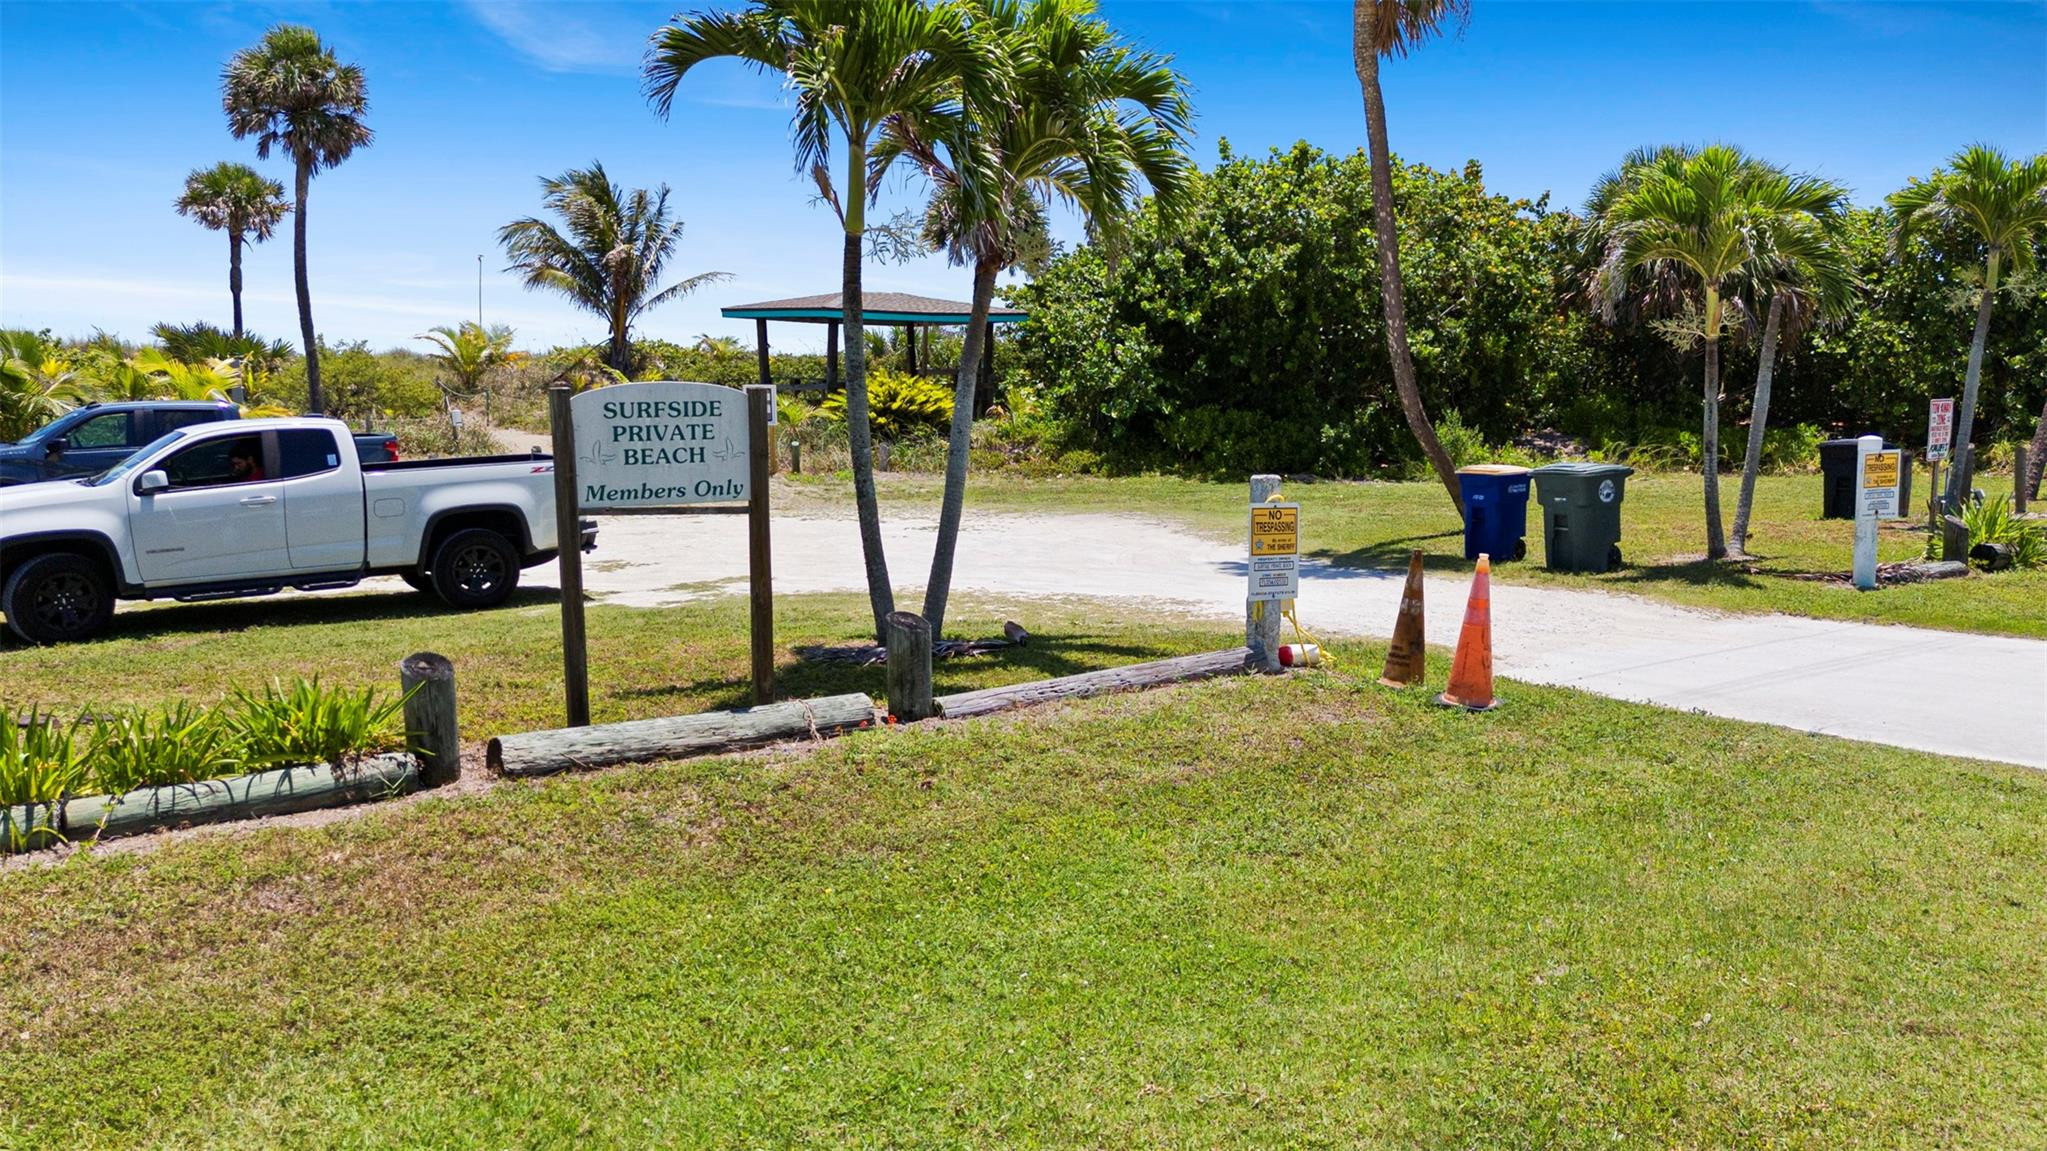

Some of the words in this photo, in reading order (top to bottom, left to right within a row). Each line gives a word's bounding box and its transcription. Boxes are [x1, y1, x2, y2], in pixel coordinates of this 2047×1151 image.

[603, 400, 722, 419] SURFSIDE
[612, 423, 715, 442] PRIVATE
[623, 446, 706, 466] BEACH
[1874, 455, 1885, 463] NO
[1866, 462, 1896, 472] TRESPASSING
[585, 482, 686, 502] Members
[694, 478, 744, 498] Only
[1268, 510, 1282, 520] NO
[1255, 521, 1295, 532] TRESPASSING
[1277, 543, 1296, 551] SHERIFF
